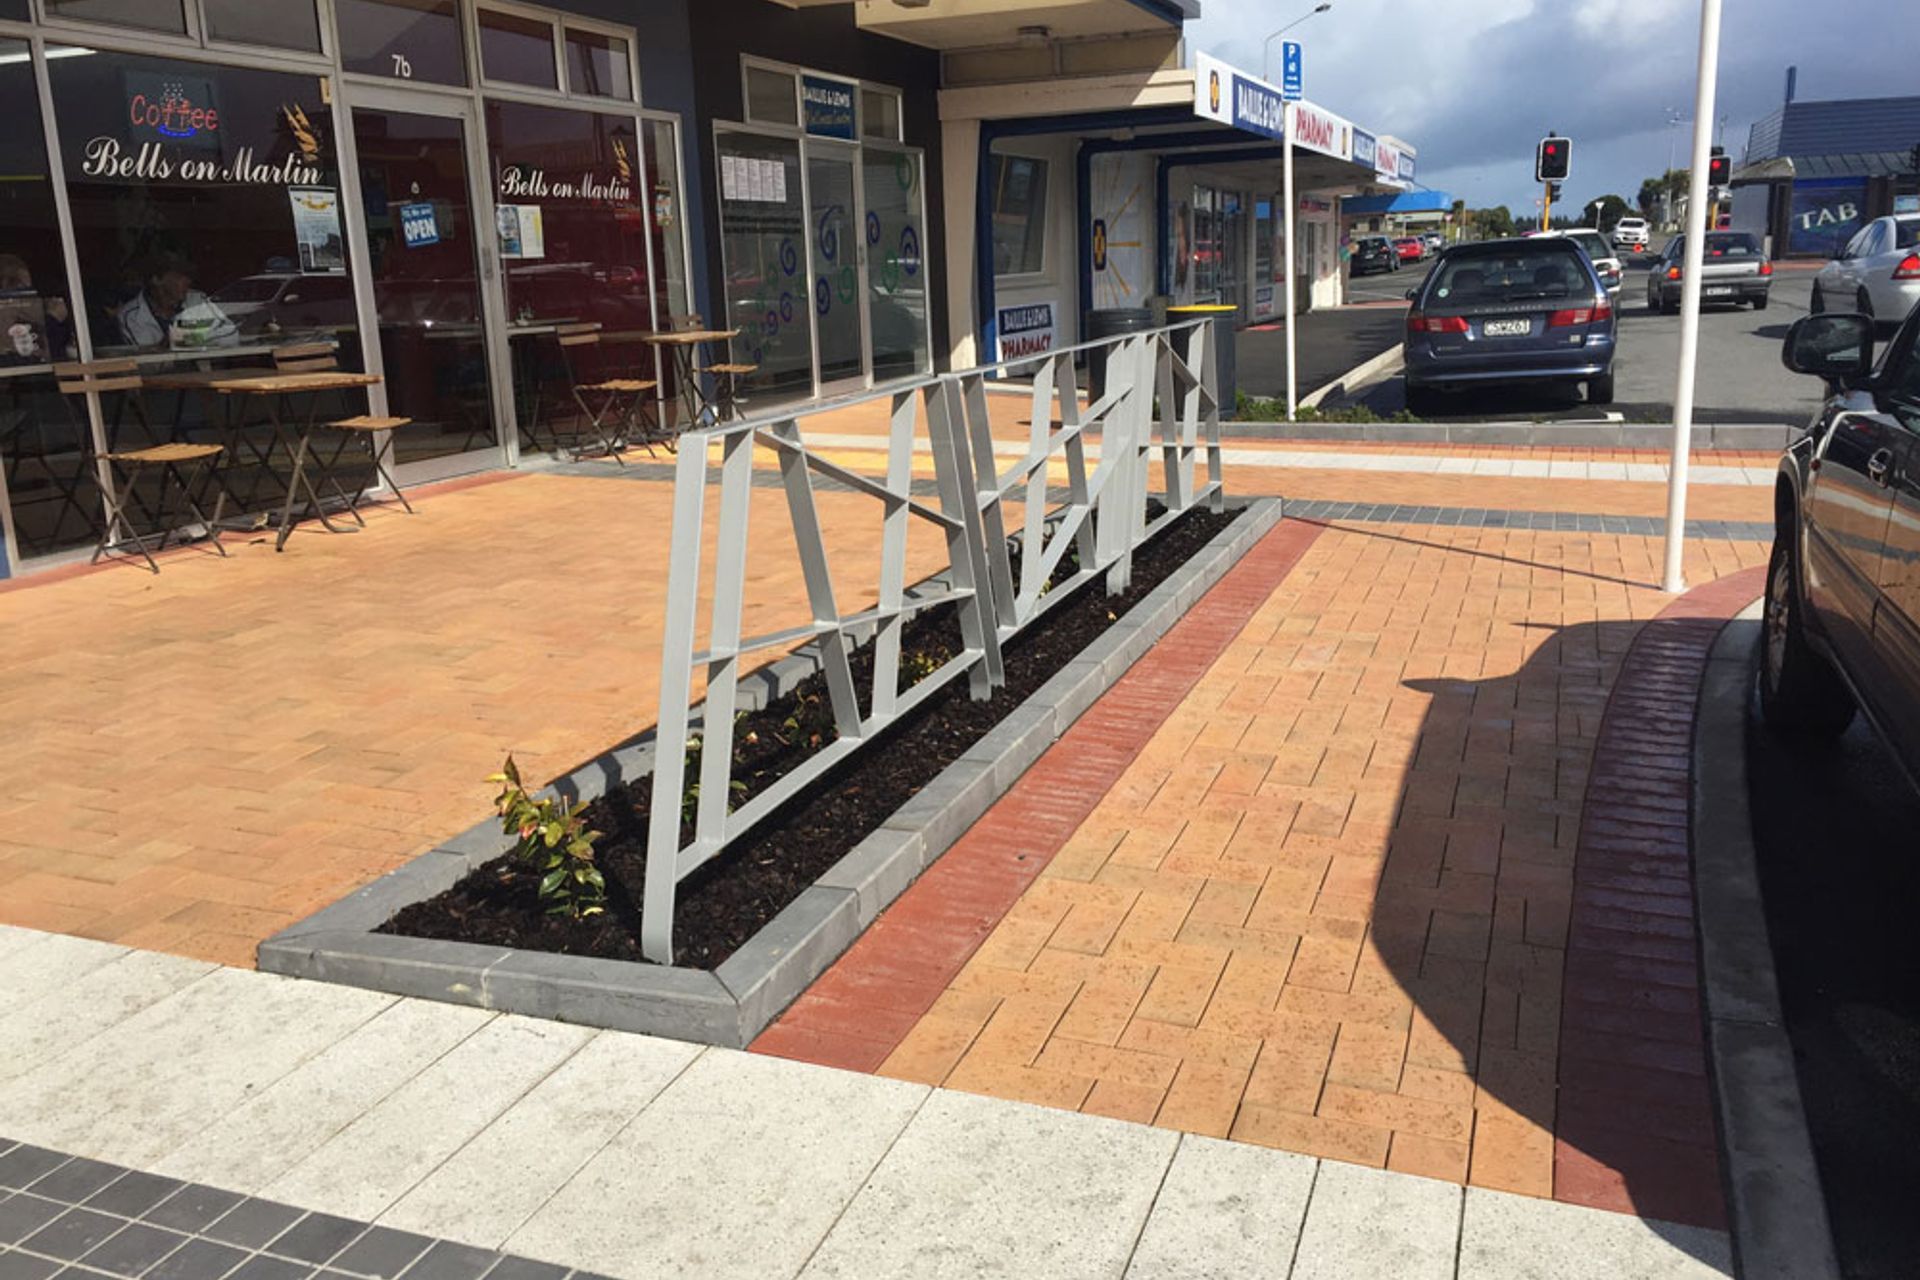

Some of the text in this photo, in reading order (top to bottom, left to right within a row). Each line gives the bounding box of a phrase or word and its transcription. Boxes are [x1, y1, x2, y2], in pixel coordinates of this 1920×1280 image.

[391, 53, 412, 78] 7b
[130, 93, 219, 130] Coffee
[1296, 106, 1334, 150] PHARMACY
[81, 135, 324, 185] Bells on Martin
[500, 165, 631, 200] Bells on Martin
[403, 217, 437, 242] OPEN
[1799, 202, 1859, 230] TAB
[1002, 333, 1051, 360] PHARMACY
